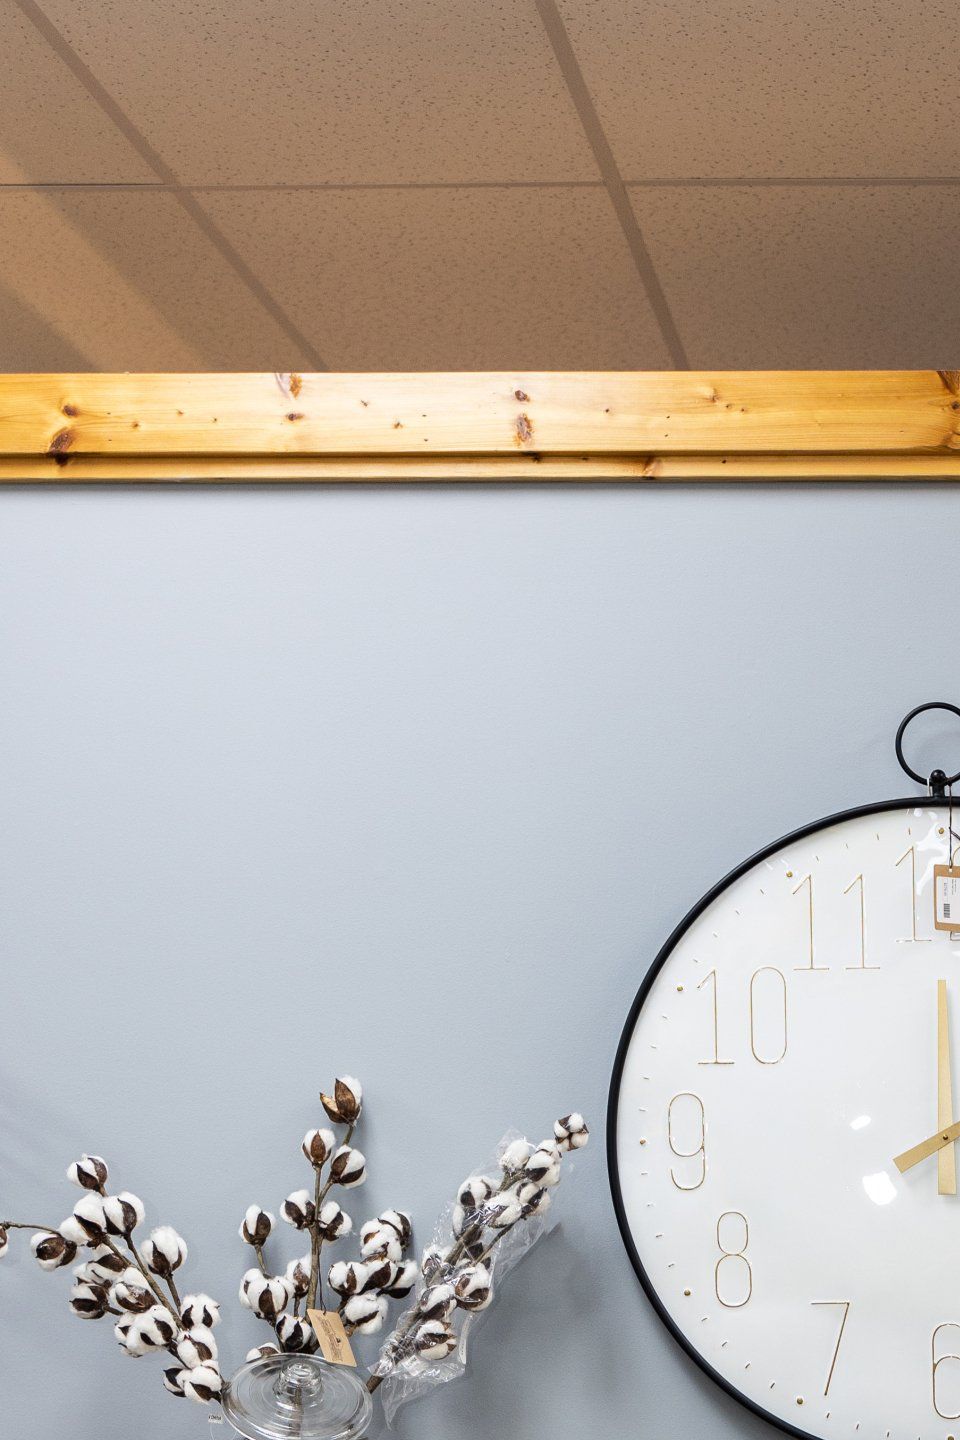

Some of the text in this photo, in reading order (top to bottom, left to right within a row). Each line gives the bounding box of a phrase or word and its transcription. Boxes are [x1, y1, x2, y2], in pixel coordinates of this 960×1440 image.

[792, 872, 882, 971] 11
[697, 966, 788, 1066] 10
[667, 1092, 706, 1191] 9
[714, 1210, 753, 1308] 8
[810, 1301, 850, 1397] 7
